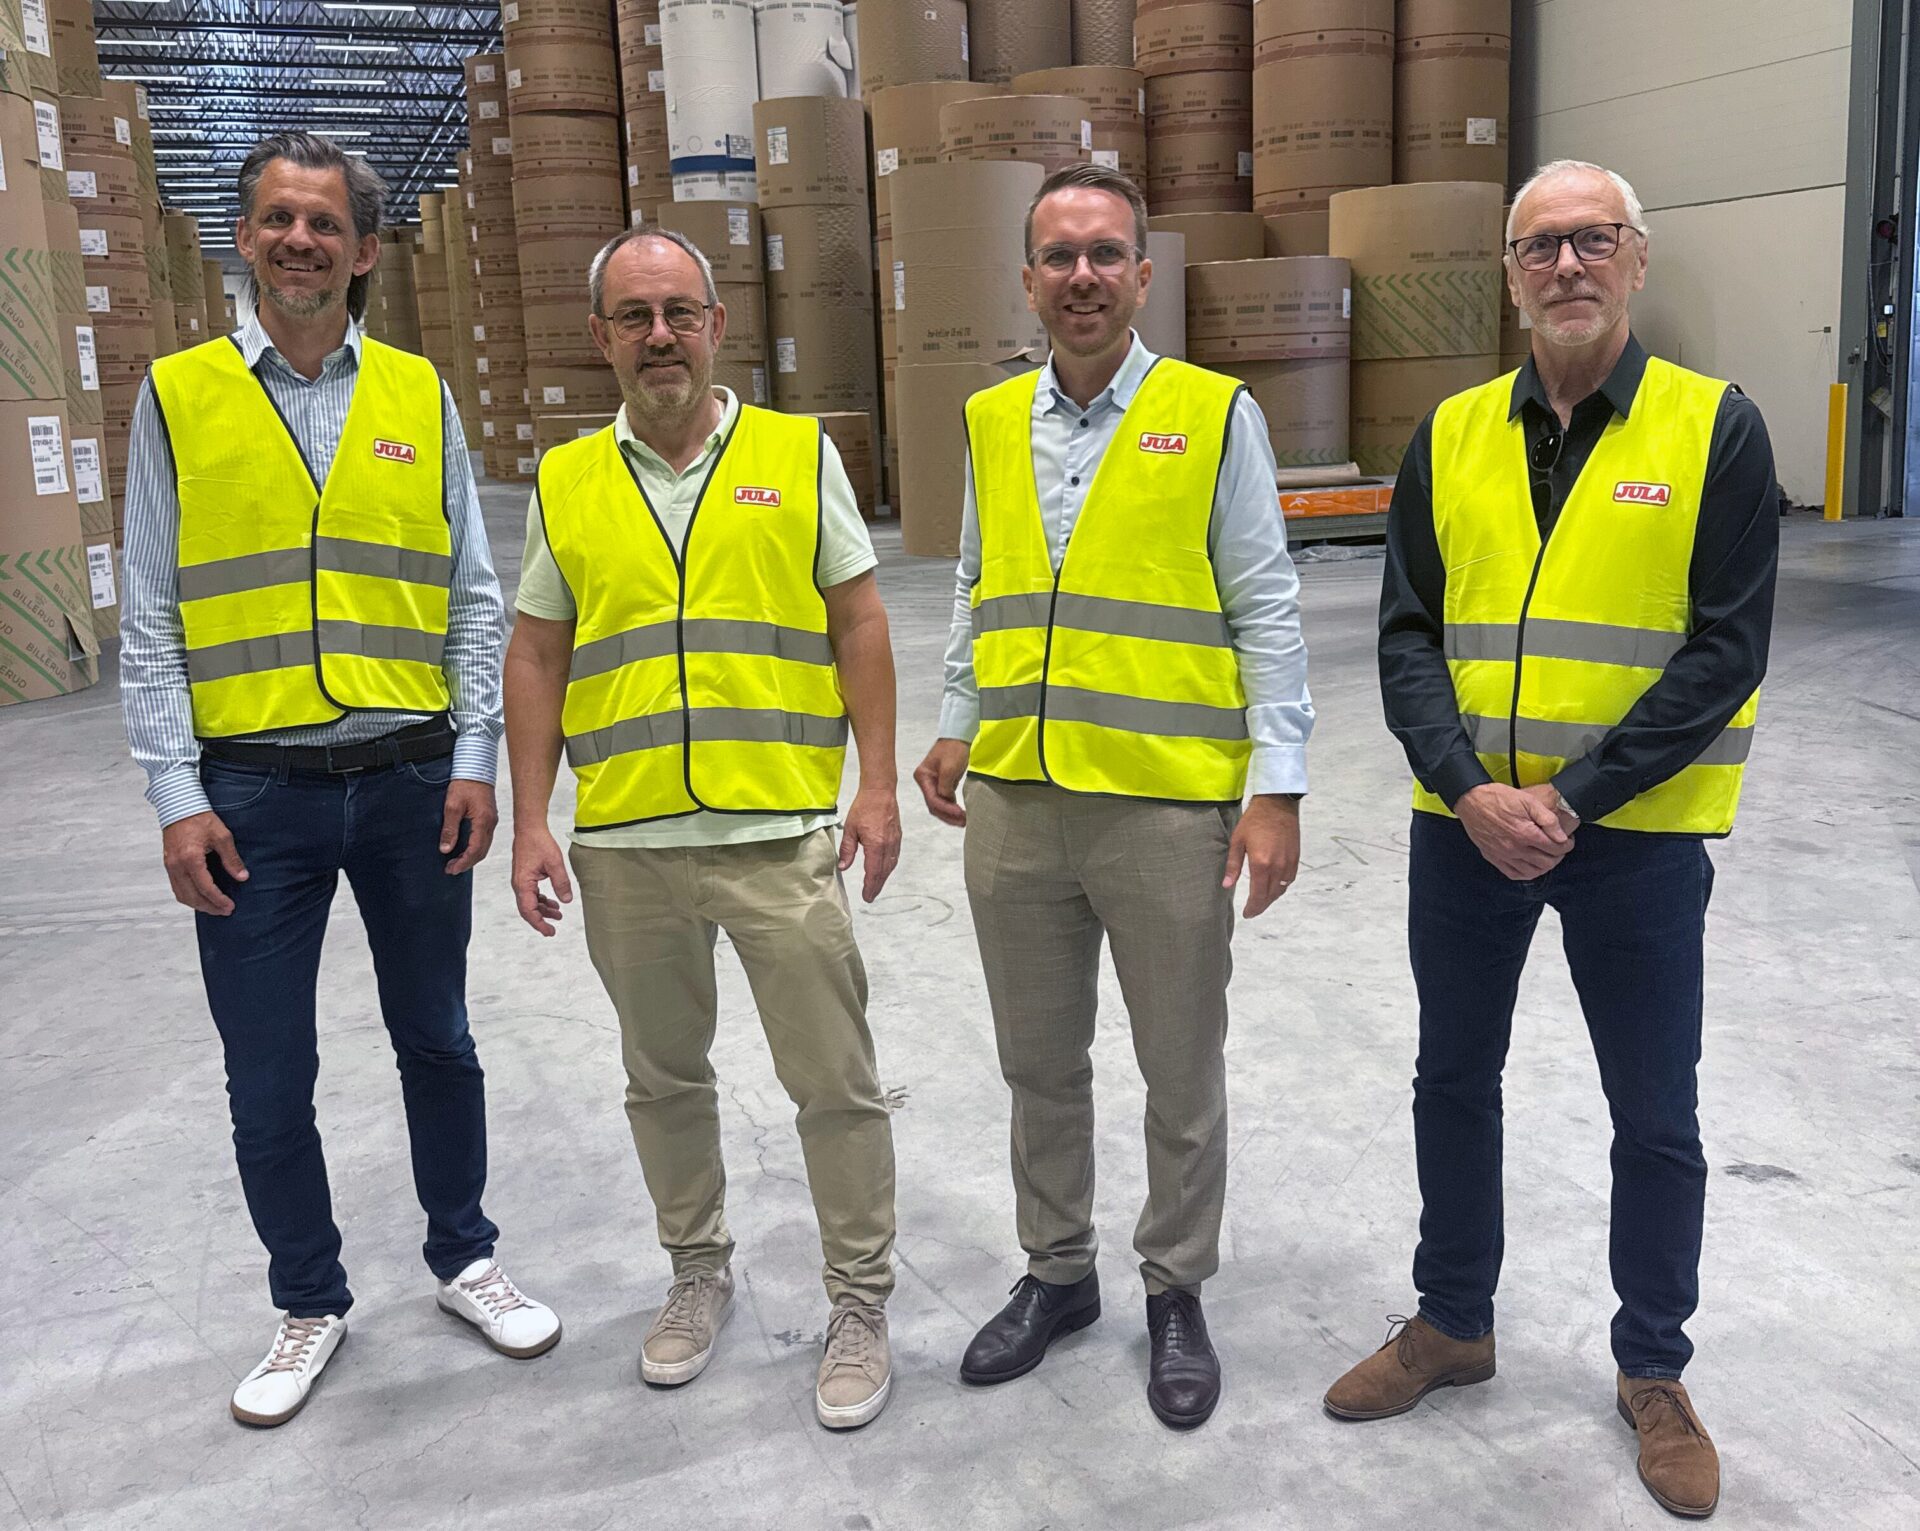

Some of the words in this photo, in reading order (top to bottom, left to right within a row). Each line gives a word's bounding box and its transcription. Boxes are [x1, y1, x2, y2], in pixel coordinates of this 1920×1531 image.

[0, 301, 24, 329] ERUD
[375, 443, 414, 461] JULA
[1141, 436, 1185, 451] JULA
[736, 490, 779, 504] JULA
[1616, 485, 1667, 502] JULA
[12, 588, 56, 628] BILLERUD
[25, 642, 67, 681] BILLERUD
